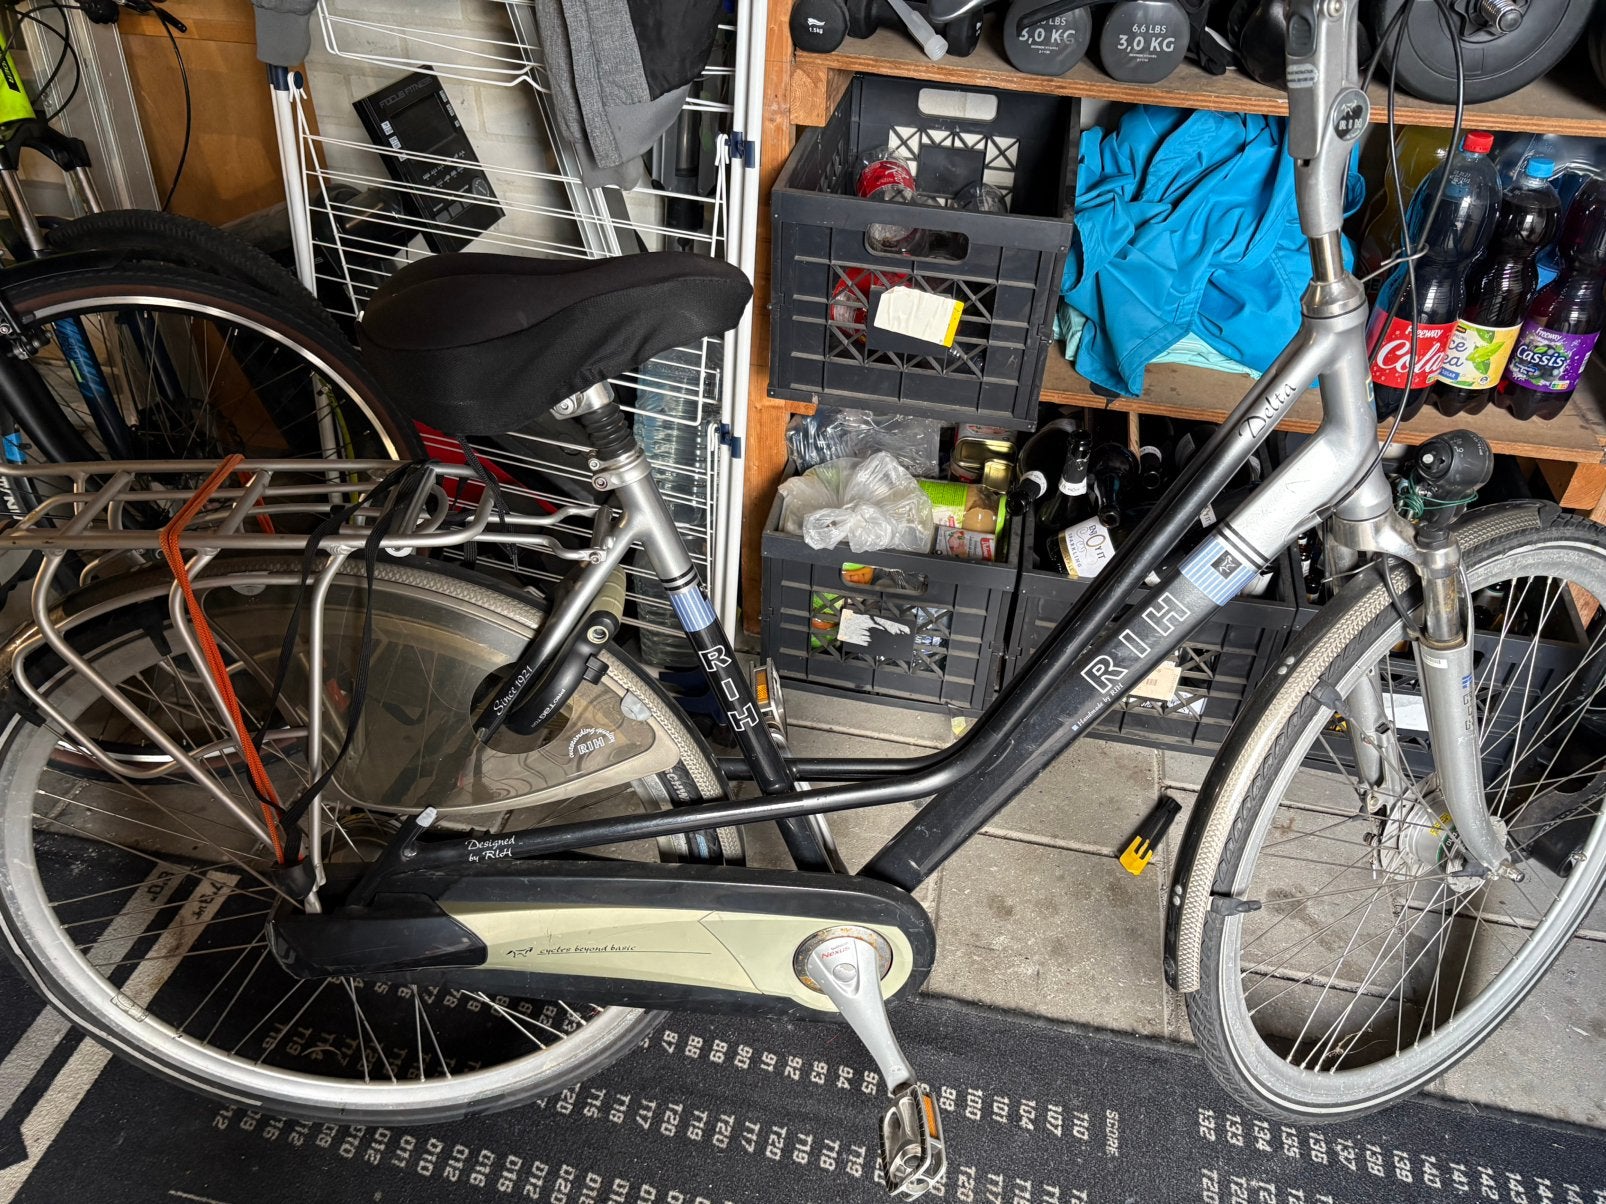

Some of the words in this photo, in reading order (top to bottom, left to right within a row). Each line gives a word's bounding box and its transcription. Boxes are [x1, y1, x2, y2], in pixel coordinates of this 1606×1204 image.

[808, 27, 824, 35] 1.5kg
[1049, 17, 1067, 26] LBS
[1051, 29, 1076, 44] KG
[1132, 23, 1147, 34] 6,6
[1149, 25, 1167, 34] LBS
[1117, 34, 1145, 53] 3,0
[1149, 37, 1175, 52] KG
[1448, 339, 1468, 352] ce
[1535, 327, 1563, 341] Freeway
[1377, 339, 1447, 373] Cola
[1441, 353, 1464, 367] ea
[1517, 345, 1566, 367] Cassis
[1238, 382, 1297, 440] Delta
[1080, 592, 1191, 694] RIH
[493, 686, 517, 716] Since
[515, 665, 533, 687] 1921
[699, 645, 760, 732] RIH
[1077, 701, 1104, 727] Handmade
[1110, 683, 1124, 697] RIH
[577, 736, 605, 755] RIH
[465, 835, 515, 850] Designed
[468, 853, 479, 862] by
[574, 944, 608, 953] beyond
[610, 944, 637, 952] basic
[821, 946, 850, 959] Nexus
[661, 1029, 679, 1053] 87
[685, 1034, 703, 1058] 88
[709, 1039, 728, 1064] 89
[734, 1044, 753, 1070] 90
[760, 1051, 777, 1073] 91
[784, 1055, 803, 1081] 92
[810, 1060, 828, 1085] 93
[836, 1065, 854, 1090] 94
[861, 1070, 879, 1095] 95
[940, 1085, 956, 1111] 98
[583, 1087, 608, 1119] T15
[609, 1093, 631, 1124] T18
[636, 1098, 657, 1130] T17
[965, 1087, 983, 1121] 100
[992, 1096, 1010, 1124] 101
[1019, 1099, 1036, 1132] 104
[660, 1102, 683, 1137] T20
[687, 1109, 709, 1141] T19
[712, 1113, 735, 1148] T20
[1046, 1104, 1063, 1137] 107
[1072, 1110, 1090, 1141] 110
[1105, 1108, 1119, 1157] SCORE
[1198, 1108, 1216, 1142] 132
[1226, 1113, 1244, 1147] 133
[364, 1127, 391, 1165] D12
[741, 1120, 761, 1153] T17
[766, 1125, 788, 1161] T20
[792, 1132, 814, 1164] T19
[1253, 1119, 1273, 1153] 134
[1281, 1125, 1300, 1158] 135
[1309, 1131, 1329, 1165] 136
[417, 1137, 444, 1176] D10
[443, 1143, 469, 1182] D12
[819, 1139, 841, 1171] T18
[846, 1143, 867, 1178] T19
[1336, 1138, 1357, 1172] 137
[1365, 1143, 1385, 1177] 138
[1393, 1150, 1413, 1184] 139
[523, 1160, 549, 1199] D12
[551, 1164, 576, 1204] D20
[957, 1166, 976, 1202] T20
[1420, 1154, 1441, 1189] 140
[1449, 1162, 1470, 1192] 141
[1477, 1166, 1499, 1200] 142
[609, 1178, 630, 1204] D1
[1505, 1172, 1529, 1204] 143
[1562, 1183, 1584, 1204] 14
